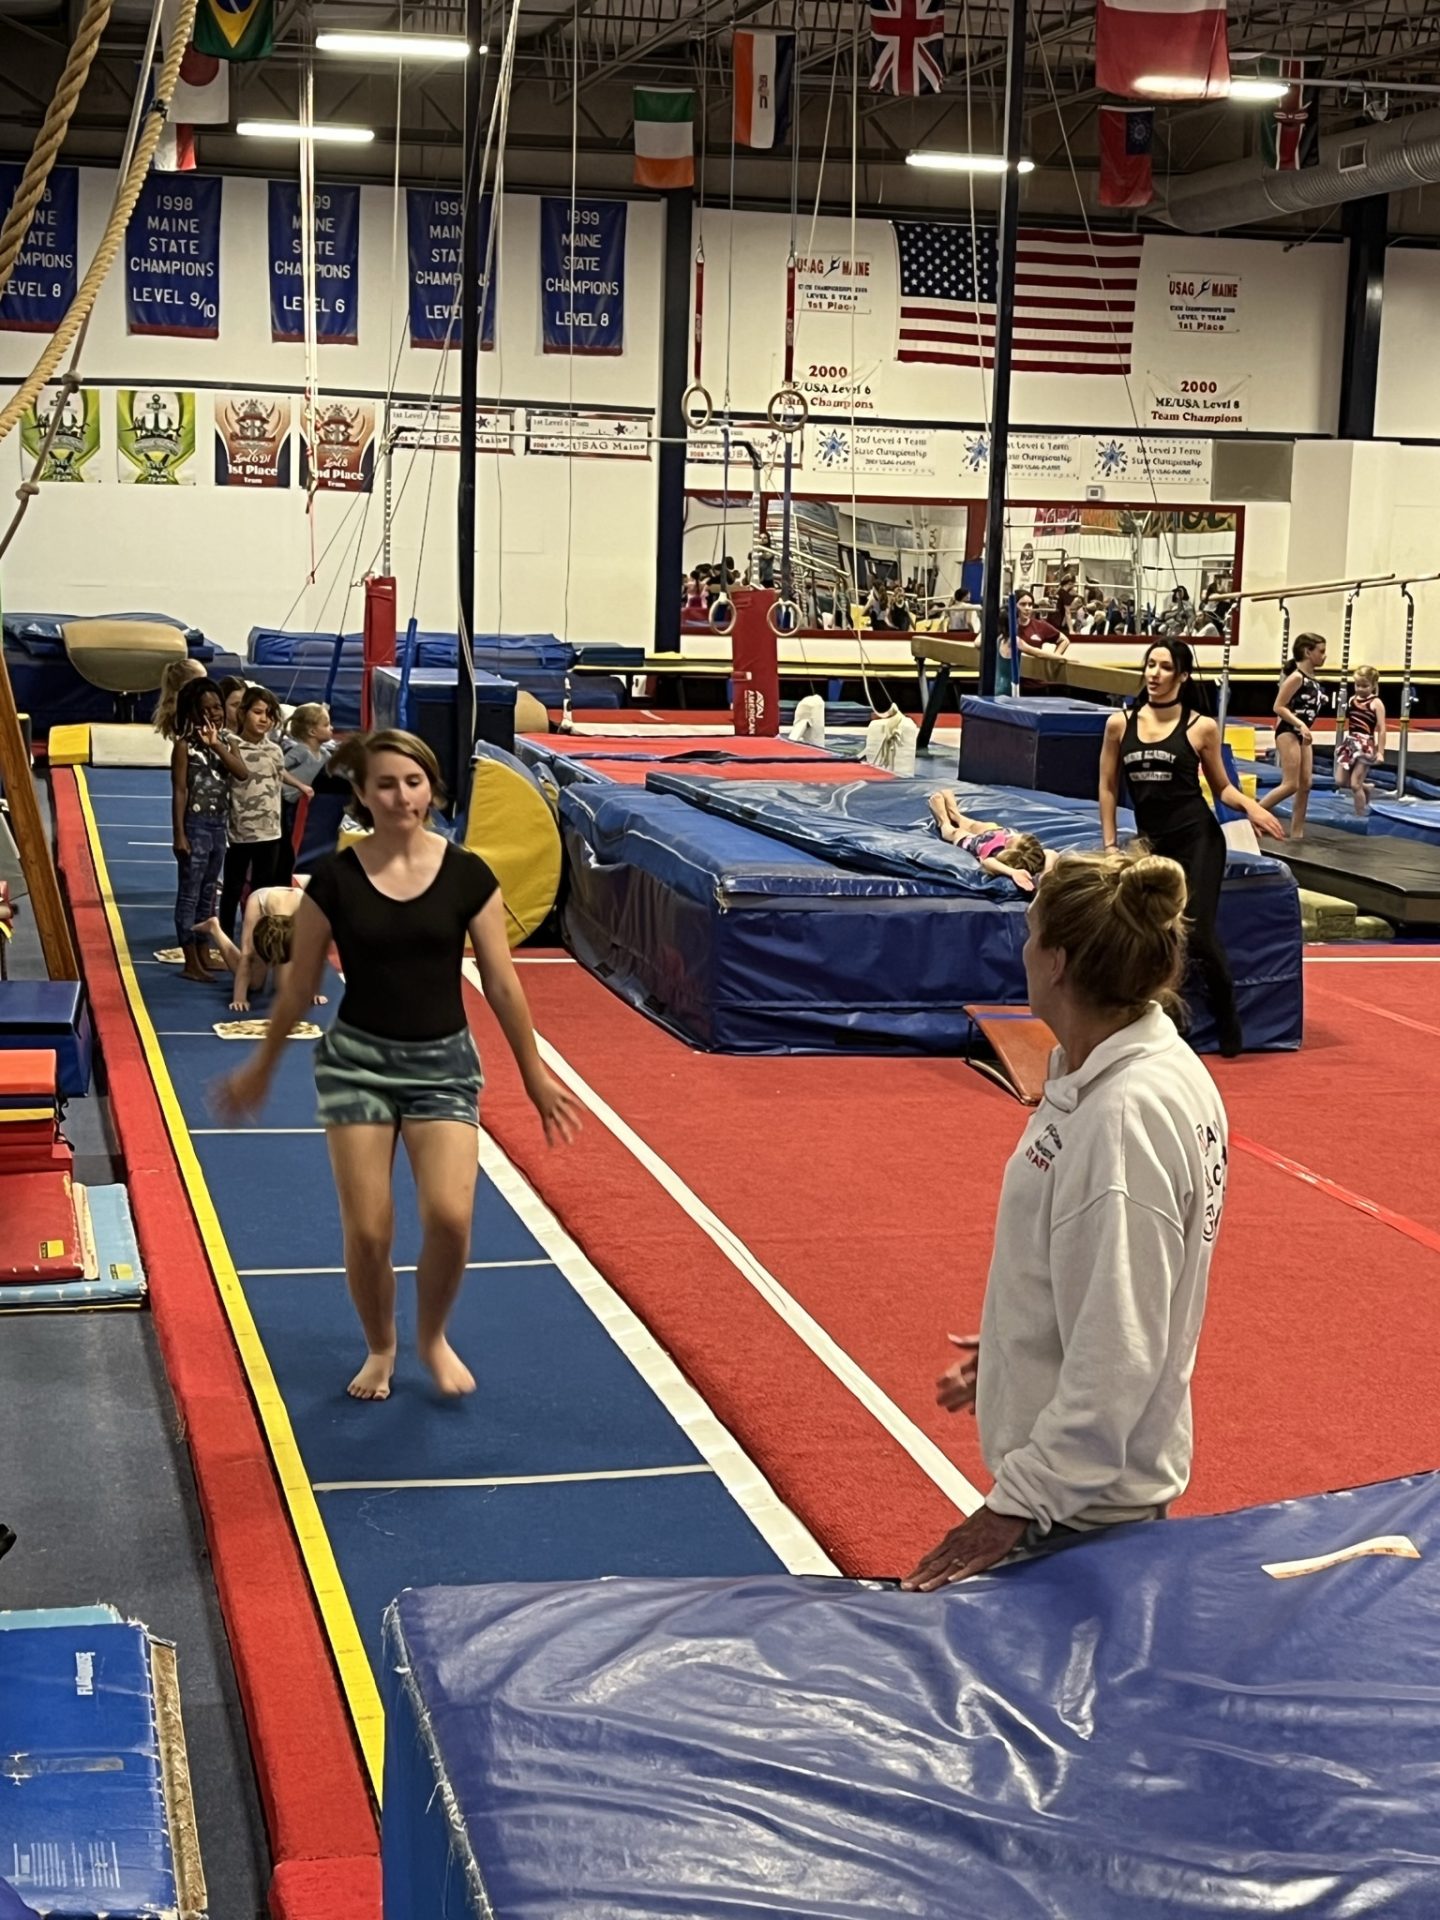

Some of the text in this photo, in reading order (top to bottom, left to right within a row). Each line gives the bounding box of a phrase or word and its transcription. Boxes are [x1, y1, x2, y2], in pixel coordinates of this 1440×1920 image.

[157, 194, 194, 211] 1998
[297, 194, 331, 210] 199
[434, 200, 464, 216] 199
[147, 216, 200, 234] MAINE
[292, 215, 336, 233] MNE
[567, 209, 600, 225] 1999
[429, 225, 464, 239] MAIN
[148, 237, 200, 255] STATE
[292, 239, 336, 256] STE
[561, 233, 602, 248] MAINE
[13, 252, 73, 269] AMPIONS
[431, 248, 464, 263] STAT
[562, 255, 601, 272] STATE
[130, 257, 215, 278] CHAMPIONS
[274, 260, 351, 280] CHAPIONS
[796, 257, 824, 274] USAG
[52, 282, 62, 298] 8
[545, 278, 620, 296] CHAMPIONS
[1169, 280, 1239, 298] USAG MAINE
[133, 287, 217, 318] LEVEL 9/10
[806, 292, 828, 300] LEVEL
[283, 295, 346, 314] LEEL 6
[425, 304, 463, 320] LEVE
[808, 301, 822, 310] 1st
[555, 311, 610, 327] LEVEL 8
[1177, 313, 1199, 321] LEVEL
[1178, 321, 1225, 331] 1st Place
[808, 365, 848, 378] 2000
[831, 383, 861, 395] Level
[864, 385, 872, 395] 6
[1180, 380, 1218, 394] 2000
[1155, 397, 1240, 410] ME/USA Level 8
[544, 419, 564, 427] Level
[1151, 410, 1243, 425] Team Champions
[572, 441, 609, 452] USAG
[612, 442, 646, 452] Maine
[872, 436, 895, 445] Level
[904, 437, 928, 446] Team
[1016, 441, 1039, 450] Level
[1149, 446, 1170, 455] Level
[227, 463, 278, 477] 1st Place
[332, 469, 365, 481] Place
